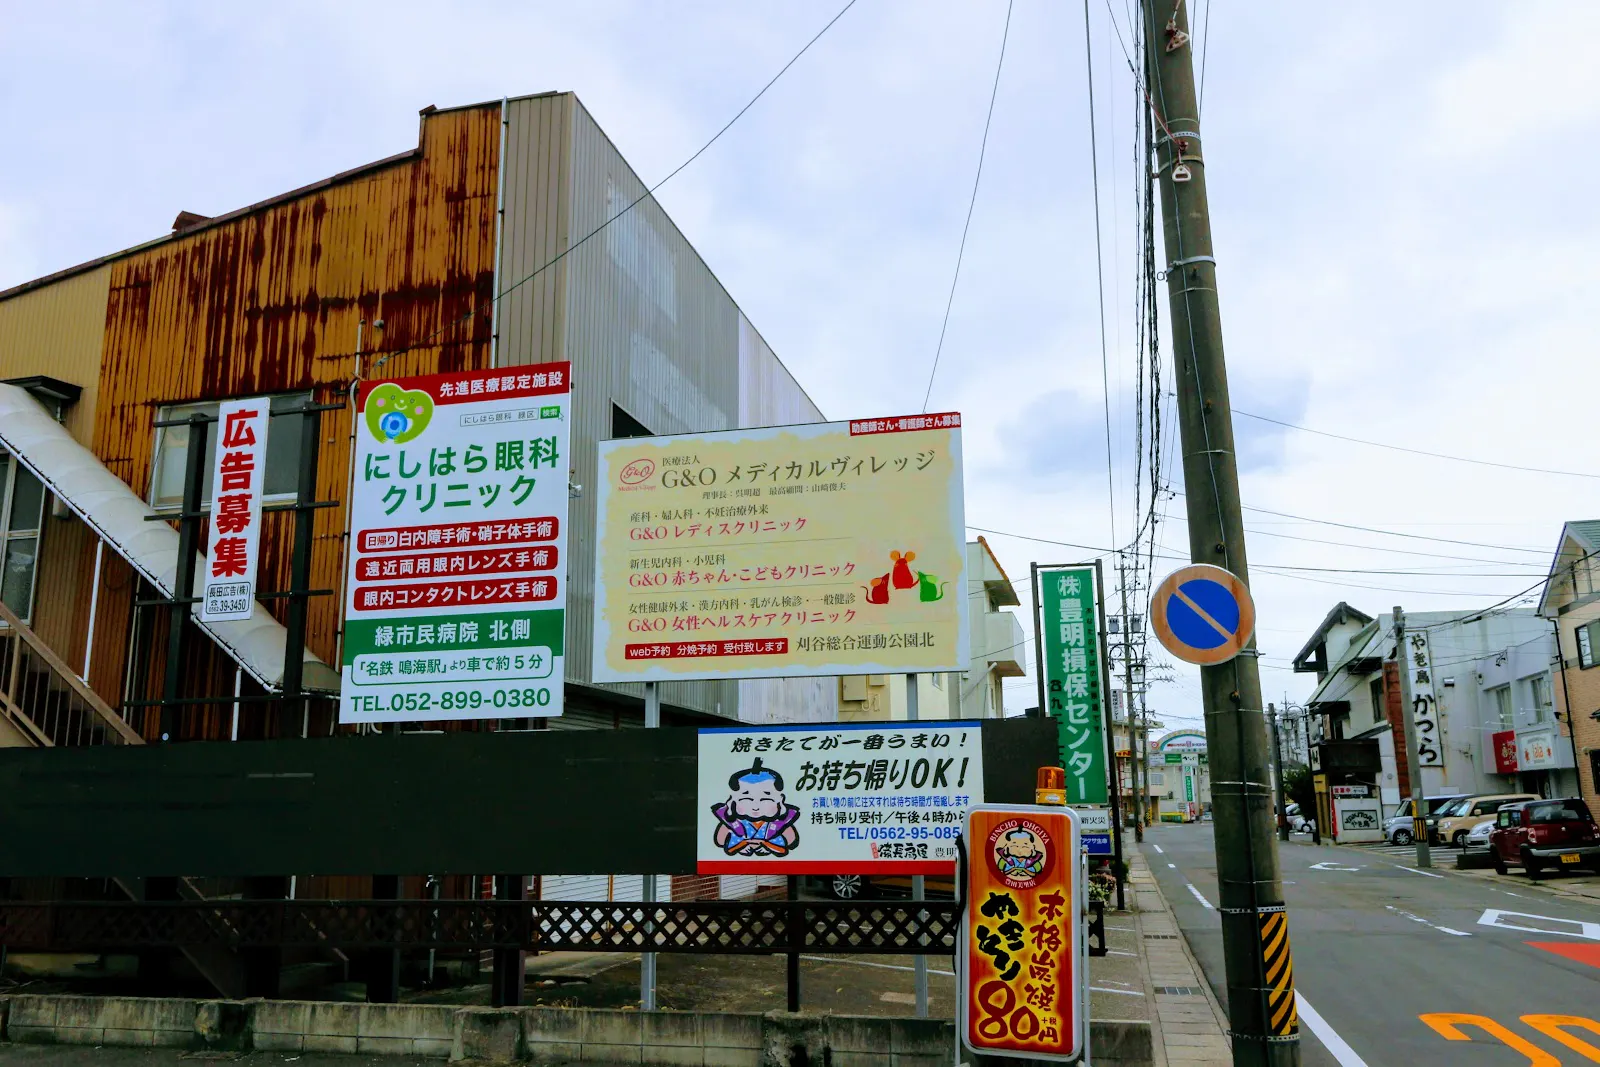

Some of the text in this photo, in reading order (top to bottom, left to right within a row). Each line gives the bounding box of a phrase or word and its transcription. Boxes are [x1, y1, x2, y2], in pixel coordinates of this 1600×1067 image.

[440, 371, 563, 397] 先進医療認定施設
[464, 412, 512, 424] にしはら眼科
[543, 408, 558, 417] 検索
[852, 415, 960, 433] 助産師さん・看護師さん募集
[364, 436, 559, 481] にしはら眼科
[662, 455, 700, 466] 医療法人
[662, 449, 935, 488] G&O メディカルヴィレッジ
[212, 409, 259, 578] 広告募集
[382, 475, 537, 516] クリニック
[630, 504, 769, 523] 産科・婦人科・不妊治療外来
[368, 521, 552, 547] 日帰り 白内障手術・硝子体手術
[630, 517, 807, 540] G&O レディスクリニック
[365, 550, 549, 577] 遠近両用眼内レンズ手術
[630, 554, 726, 569] 新生児内科・小児科
[629, 562, 856, 587] G&O 赤ちゃん・こどもクリニック
[363, 581, 548, 606] 眼内コンタクトレンズ手術
[628, 593, 856, 615] 女性健康外来・漢方内科・乳がん検診・一般健診
[628, 609, 856, 632] G&O 女性ヘルスケアクリニック
[374, 619, 531, 647] 緑市民病院 北側
[796, 632, 935, 652] 刈谷総合運動公園北
[630, 641, 785, 657] web予約 分娩予約 受付致します
[359, 661, 393, 677] 「名鉄
[351, 687, 551, 712] TEL.052-899-0380
[1411, 633, 1438, 763] やき鳥 かつら
[731, 733, 968, 753] 焼きたてが一番うまい！
[795, 757, 969, 791] お持ち帰りOK！
[838, 827, 962, 840] TEL/0562-95-085
[990, 820, 1050, 845] BINCHO OHGIYA
[935, 847, 959, 859] 豊明
[976, 892, 1025, 982] やきとり
